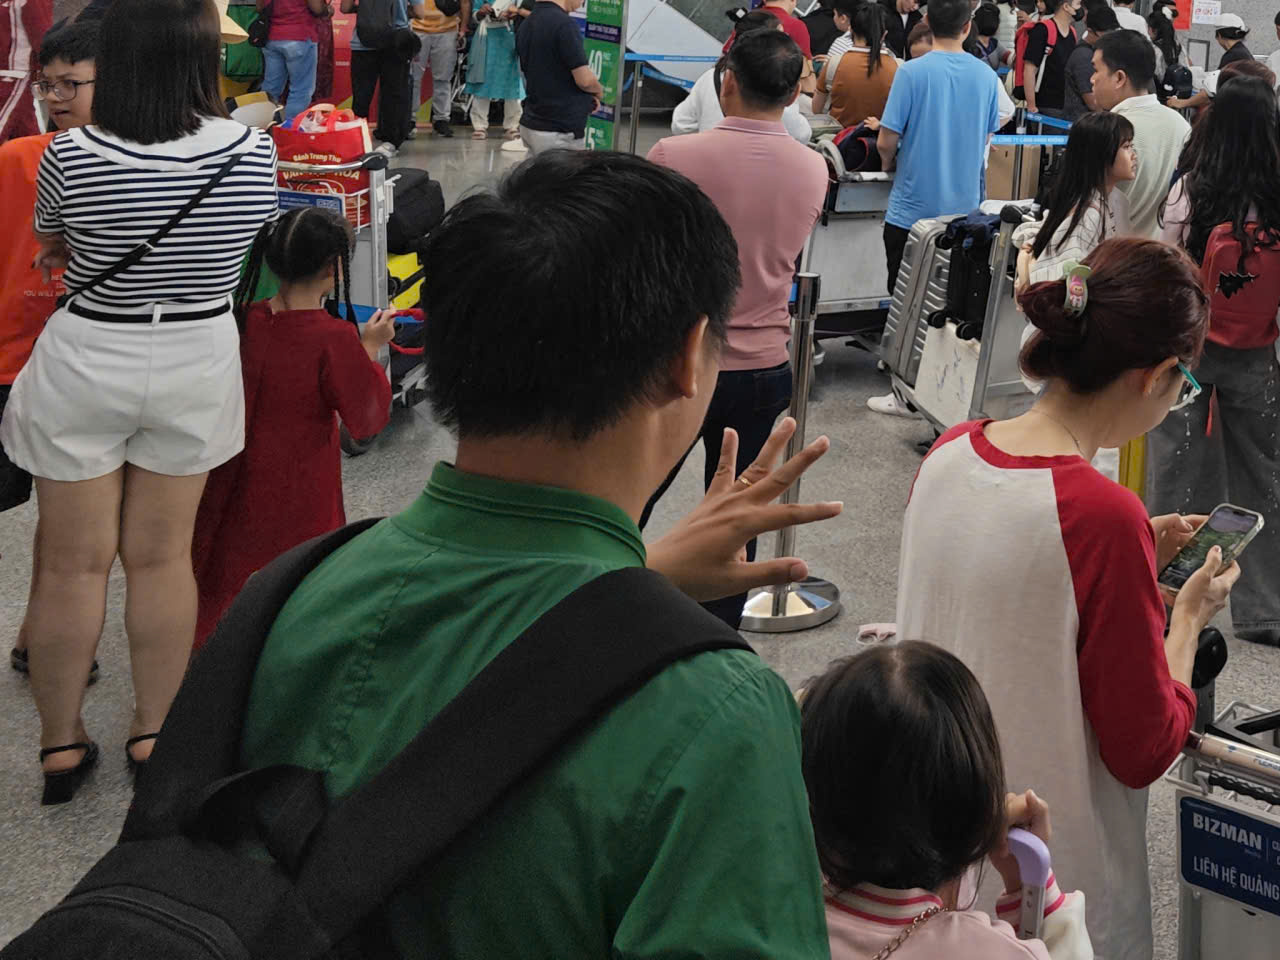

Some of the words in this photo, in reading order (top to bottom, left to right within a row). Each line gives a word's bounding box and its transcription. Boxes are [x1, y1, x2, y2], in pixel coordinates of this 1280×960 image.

[309, 152, 328, 162] Trung
[1192, 812, 1262, 851] BIZMAN
[1193, 855, 1219, 880] LIÊN
[1221, 866, 1238, 890] HỆ
[1239, 872, 1280, 902] QUẢNG
